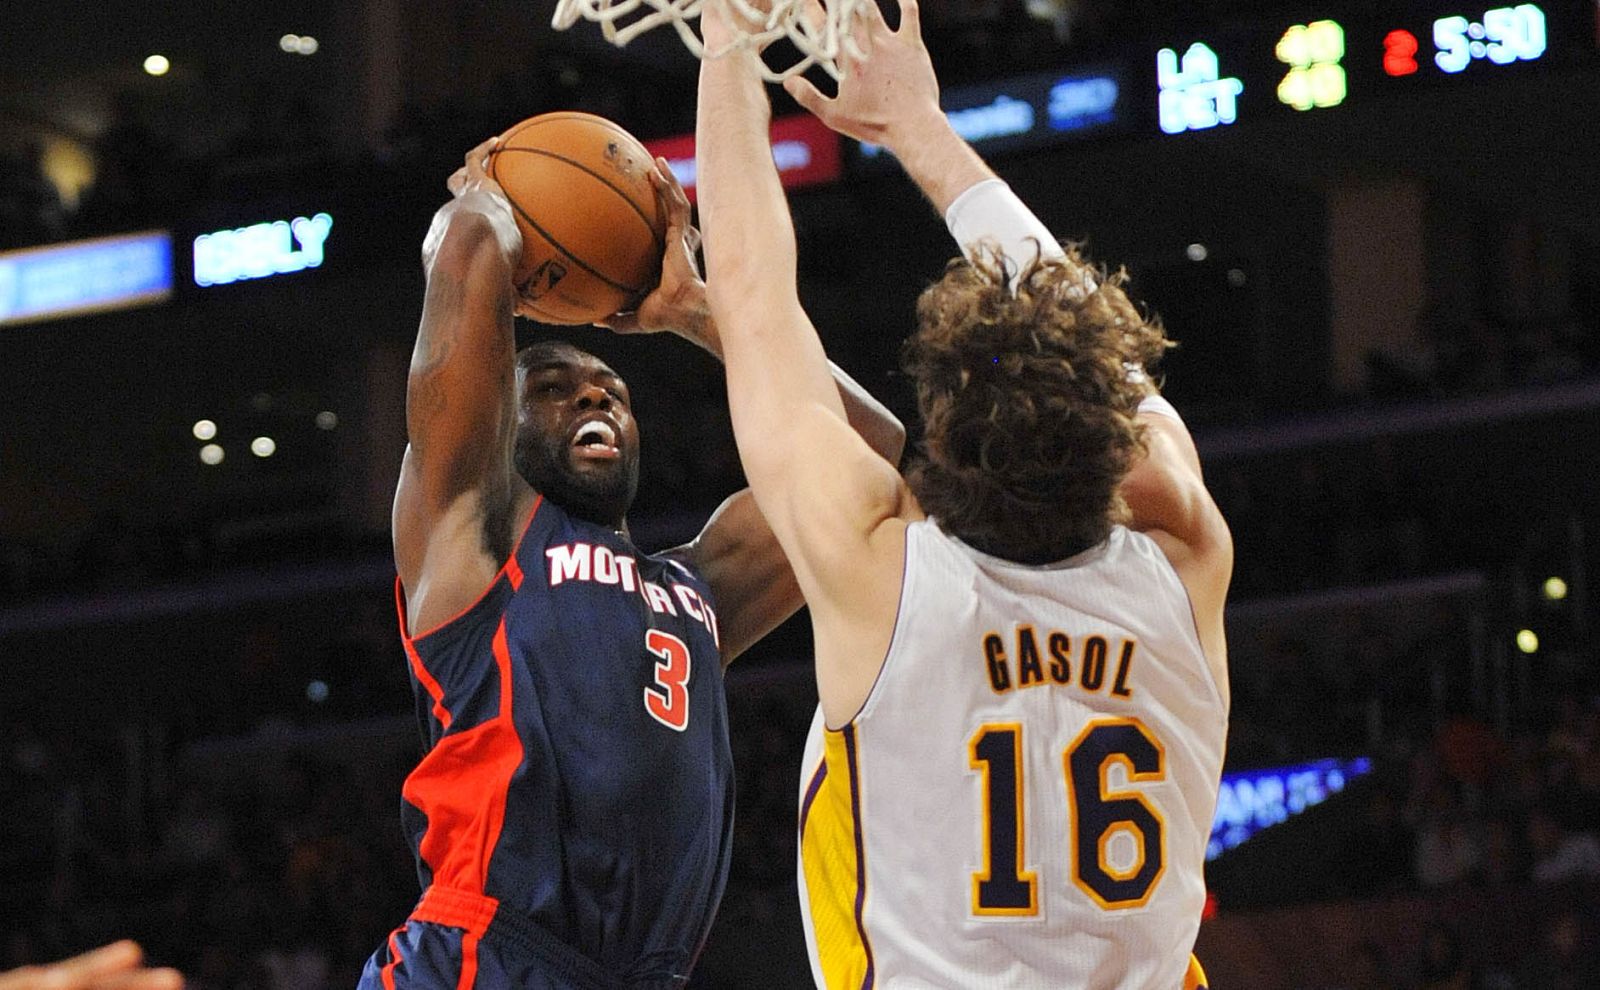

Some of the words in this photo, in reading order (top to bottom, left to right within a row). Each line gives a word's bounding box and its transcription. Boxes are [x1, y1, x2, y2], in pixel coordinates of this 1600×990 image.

[1157, 42, 1219, 91] LA
[1383, 29, 1419, 76] 2
[1433, 4, 1547, 73] 5:50
[545, 542, 679, 618] MOTR
[644, 628, 691, 732] 3
[982, 623, 1137, 698] GASOL
[967, 716, 1166, 916] 16
